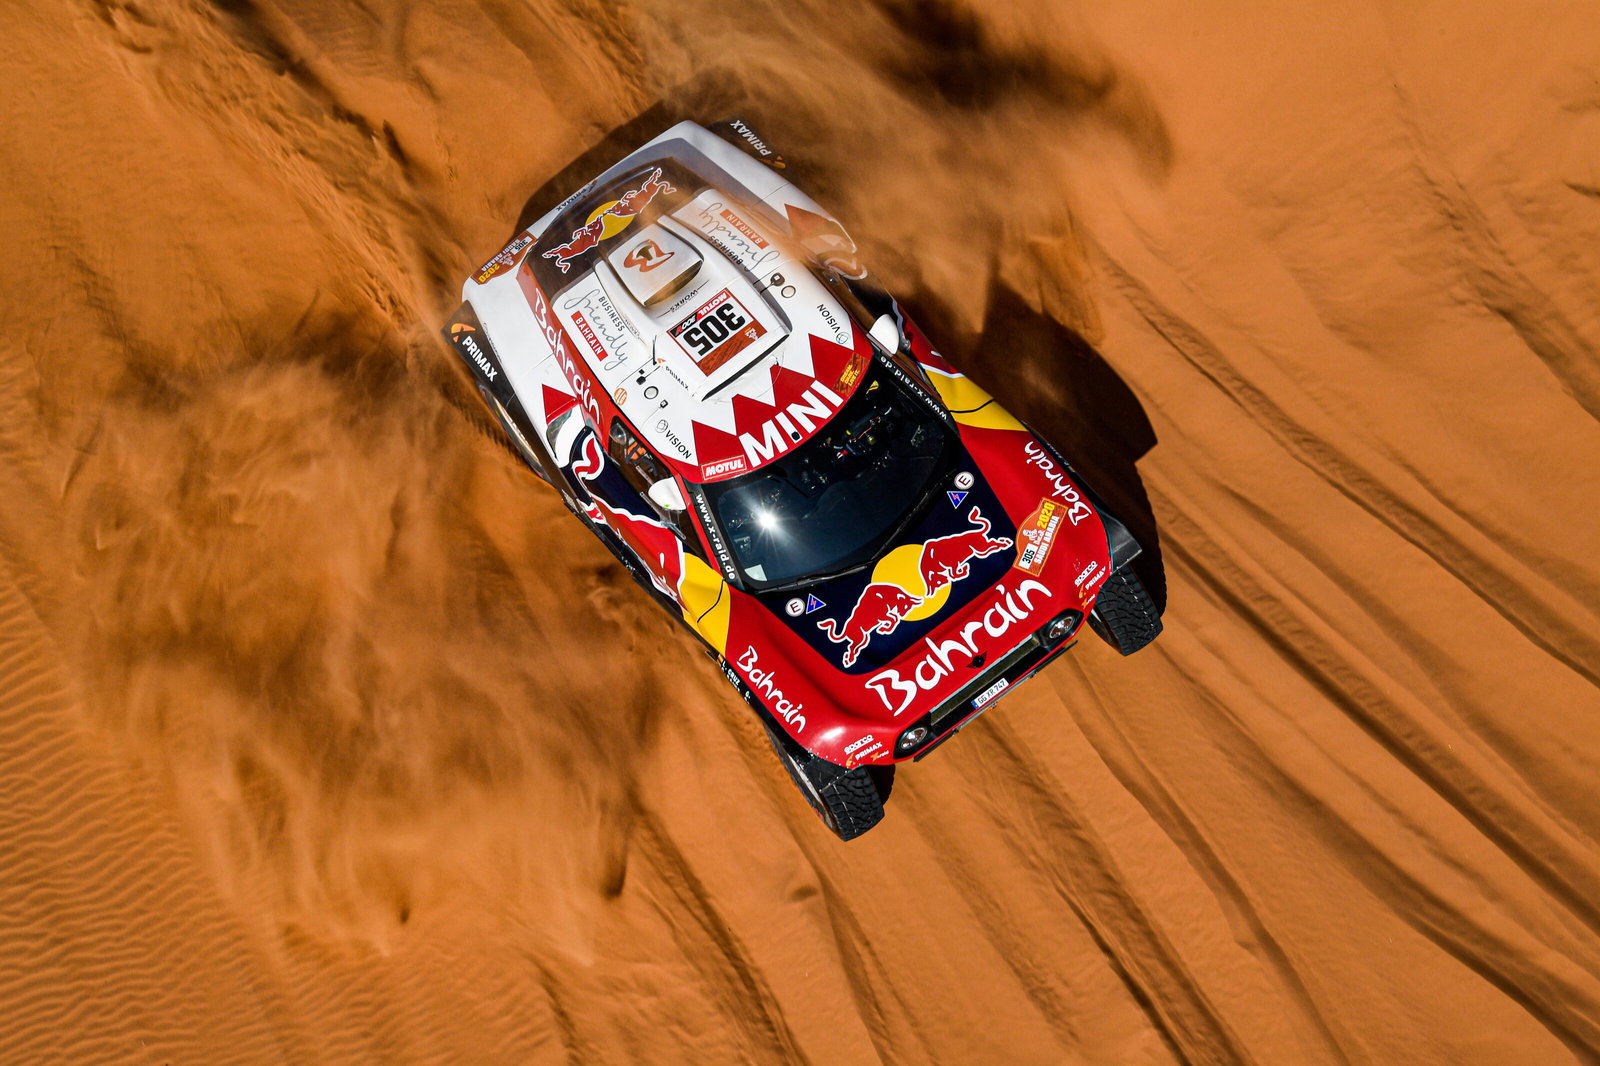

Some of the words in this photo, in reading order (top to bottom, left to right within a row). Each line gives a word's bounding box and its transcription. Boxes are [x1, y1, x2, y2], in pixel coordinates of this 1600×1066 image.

[730, 120, 772, 155] PRIMAX
[556, 188, 587, 211] PRIMAX
[727, 214, 764, 244] BAHRAIN
[515, 240, 529, 252] 305
[710, 236, 744, 265] BUSINESS
[478, 263, 501, 283] 2020
[599, 296, 625, 332] BUSINESS
[670, 289, 698, 311] WORKS
[698, 292, 728, 315] MOTUL
[564, 289, 628, 371] friendly
[683, 303, 746, 357] 305
[817, 304, 841, 333] VISION
[575, 317, 604, 355] BAHRAIN
[462, 336, 498, 382] PRIMAX
[535, 288, 600, 425] Bahrain
[665, 366, 689, 391] PRIMAX
[880, 356, 948, 421] www.x-raid.de
[738, 379, 844, 468] MINI
[665, 430, 692, 459] VISION
[705, 458, 744, 477] MOTUL
[1024, 441, 1093, 527] Bahrain
[1037, 502, 1056, 529] 2020
[695, 493, 736, 580] www.x-raid.de
[1033, 543, 1050, 565] SAUDI
[1043, 516, 1060, 543] ARABIA
[1022, 549, 1035, 564] 305
[864, 579, 1052, 717] Bahrain
[736, 645, 807, 734] Bahrain
[993, 680, 1006, 692] 747
[844, 734, 874, 755] sparco
[855, 742, 883, 760] PRIMAX
